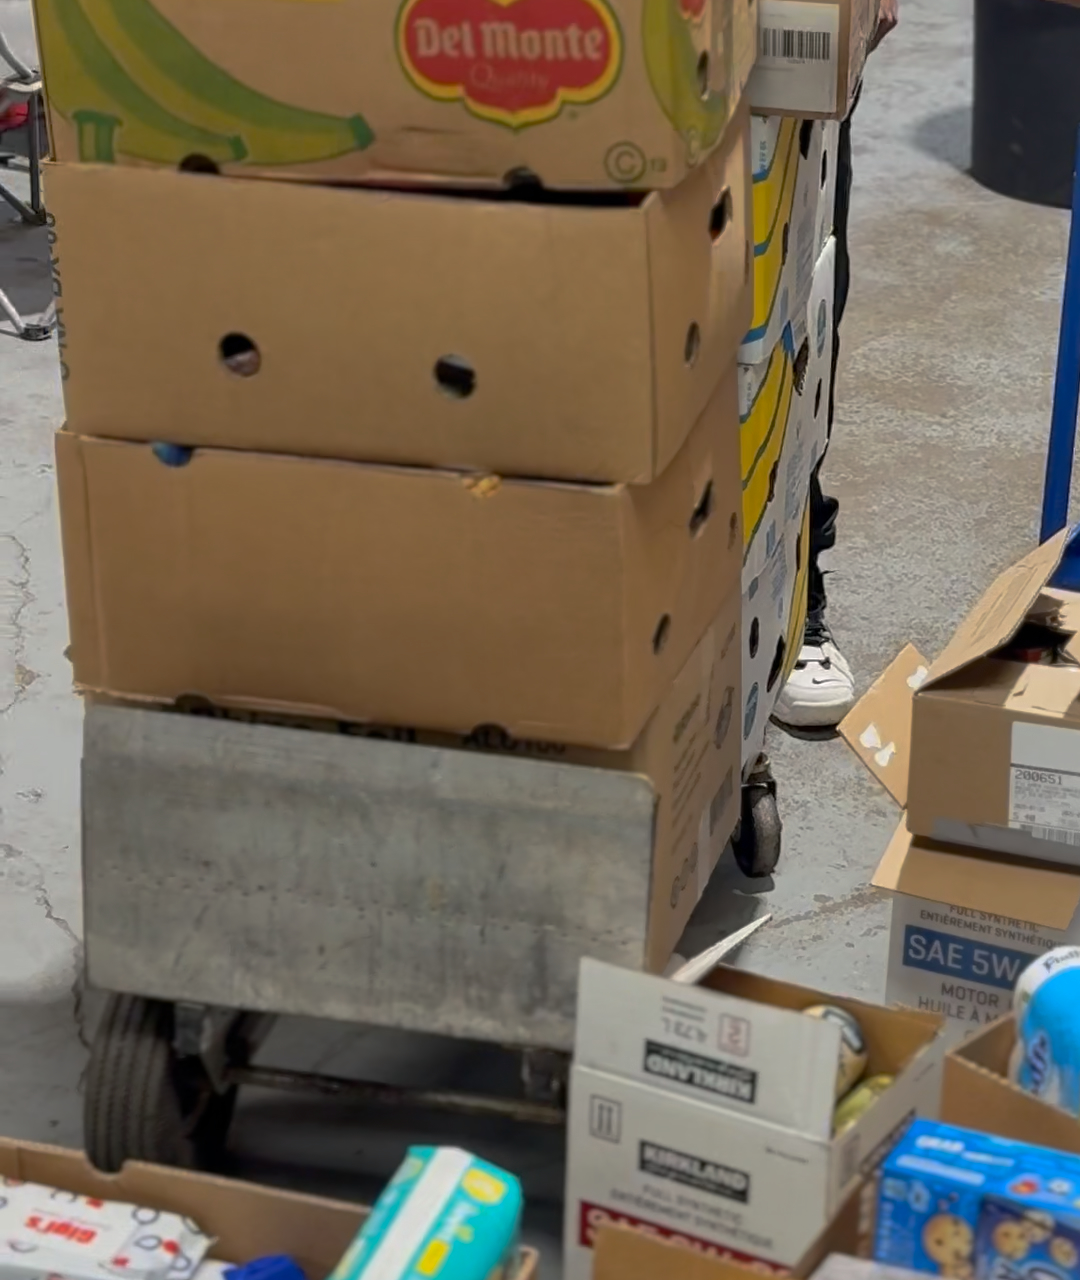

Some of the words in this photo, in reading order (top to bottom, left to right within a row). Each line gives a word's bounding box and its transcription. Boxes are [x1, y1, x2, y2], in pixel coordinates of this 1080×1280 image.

[413, 17, 476, 59] Del
[480, 21, 604, 61] Monte
[469, 62, 549, 92] Quality
[920, 909, 992, 935] ENTIÈREMENT
[950, 904, 977, 919] FULL
[908, 934, 964, 970] SAE
[918, 996, 966, 1021] HUILE
[941, 982, 1000, 1008] MOTOR
[645, 1053, 755, 1103] KIRKLAND
[642, 1142, 749, 1192] KIRKLAND
